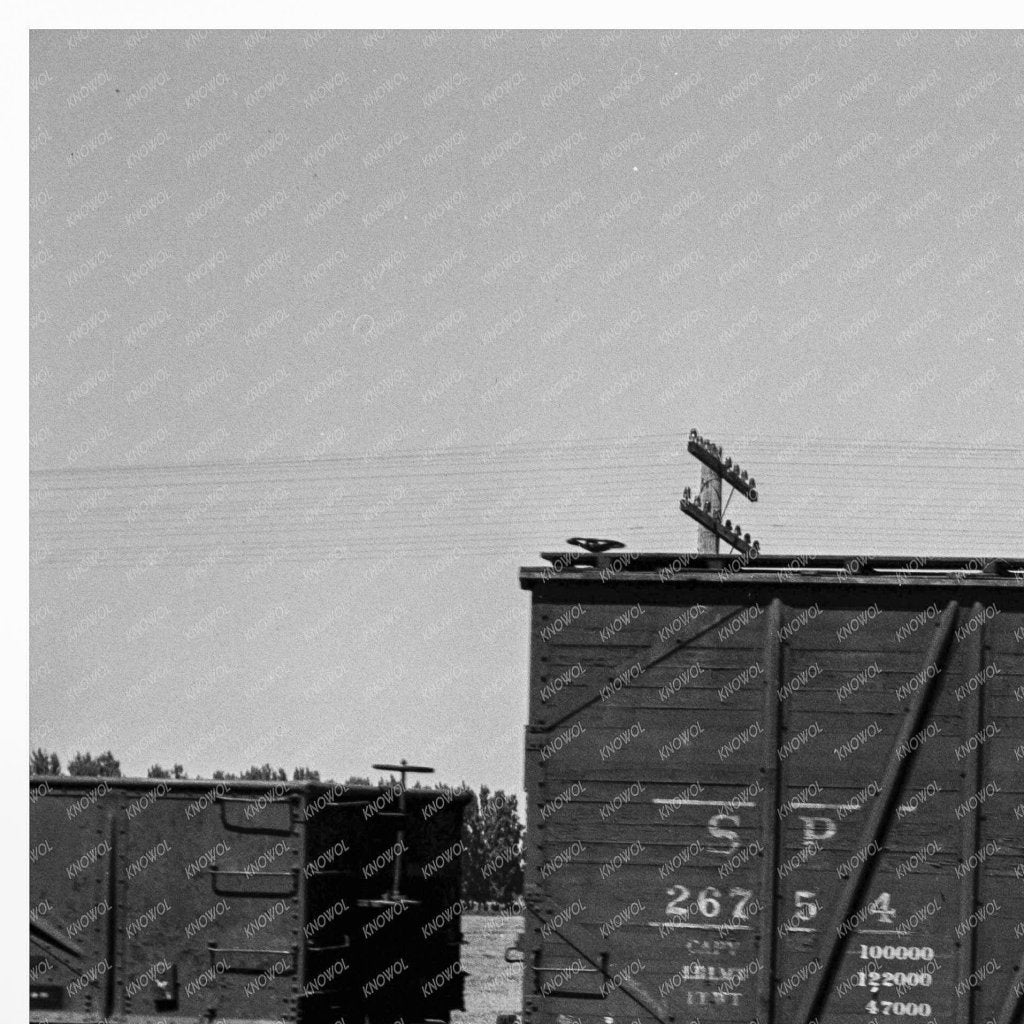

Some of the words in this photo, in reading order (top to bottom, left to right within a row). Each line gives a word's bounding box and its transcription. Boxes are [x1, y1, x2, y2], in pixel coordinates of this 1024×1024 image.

[707, 814, 741, 854] S
[799, 816, 838, 858] P
[859, 944, 935, 961] 100000
[857, 971, 932, 987] 122000
[865, 1000, 932, 1017] 47000
